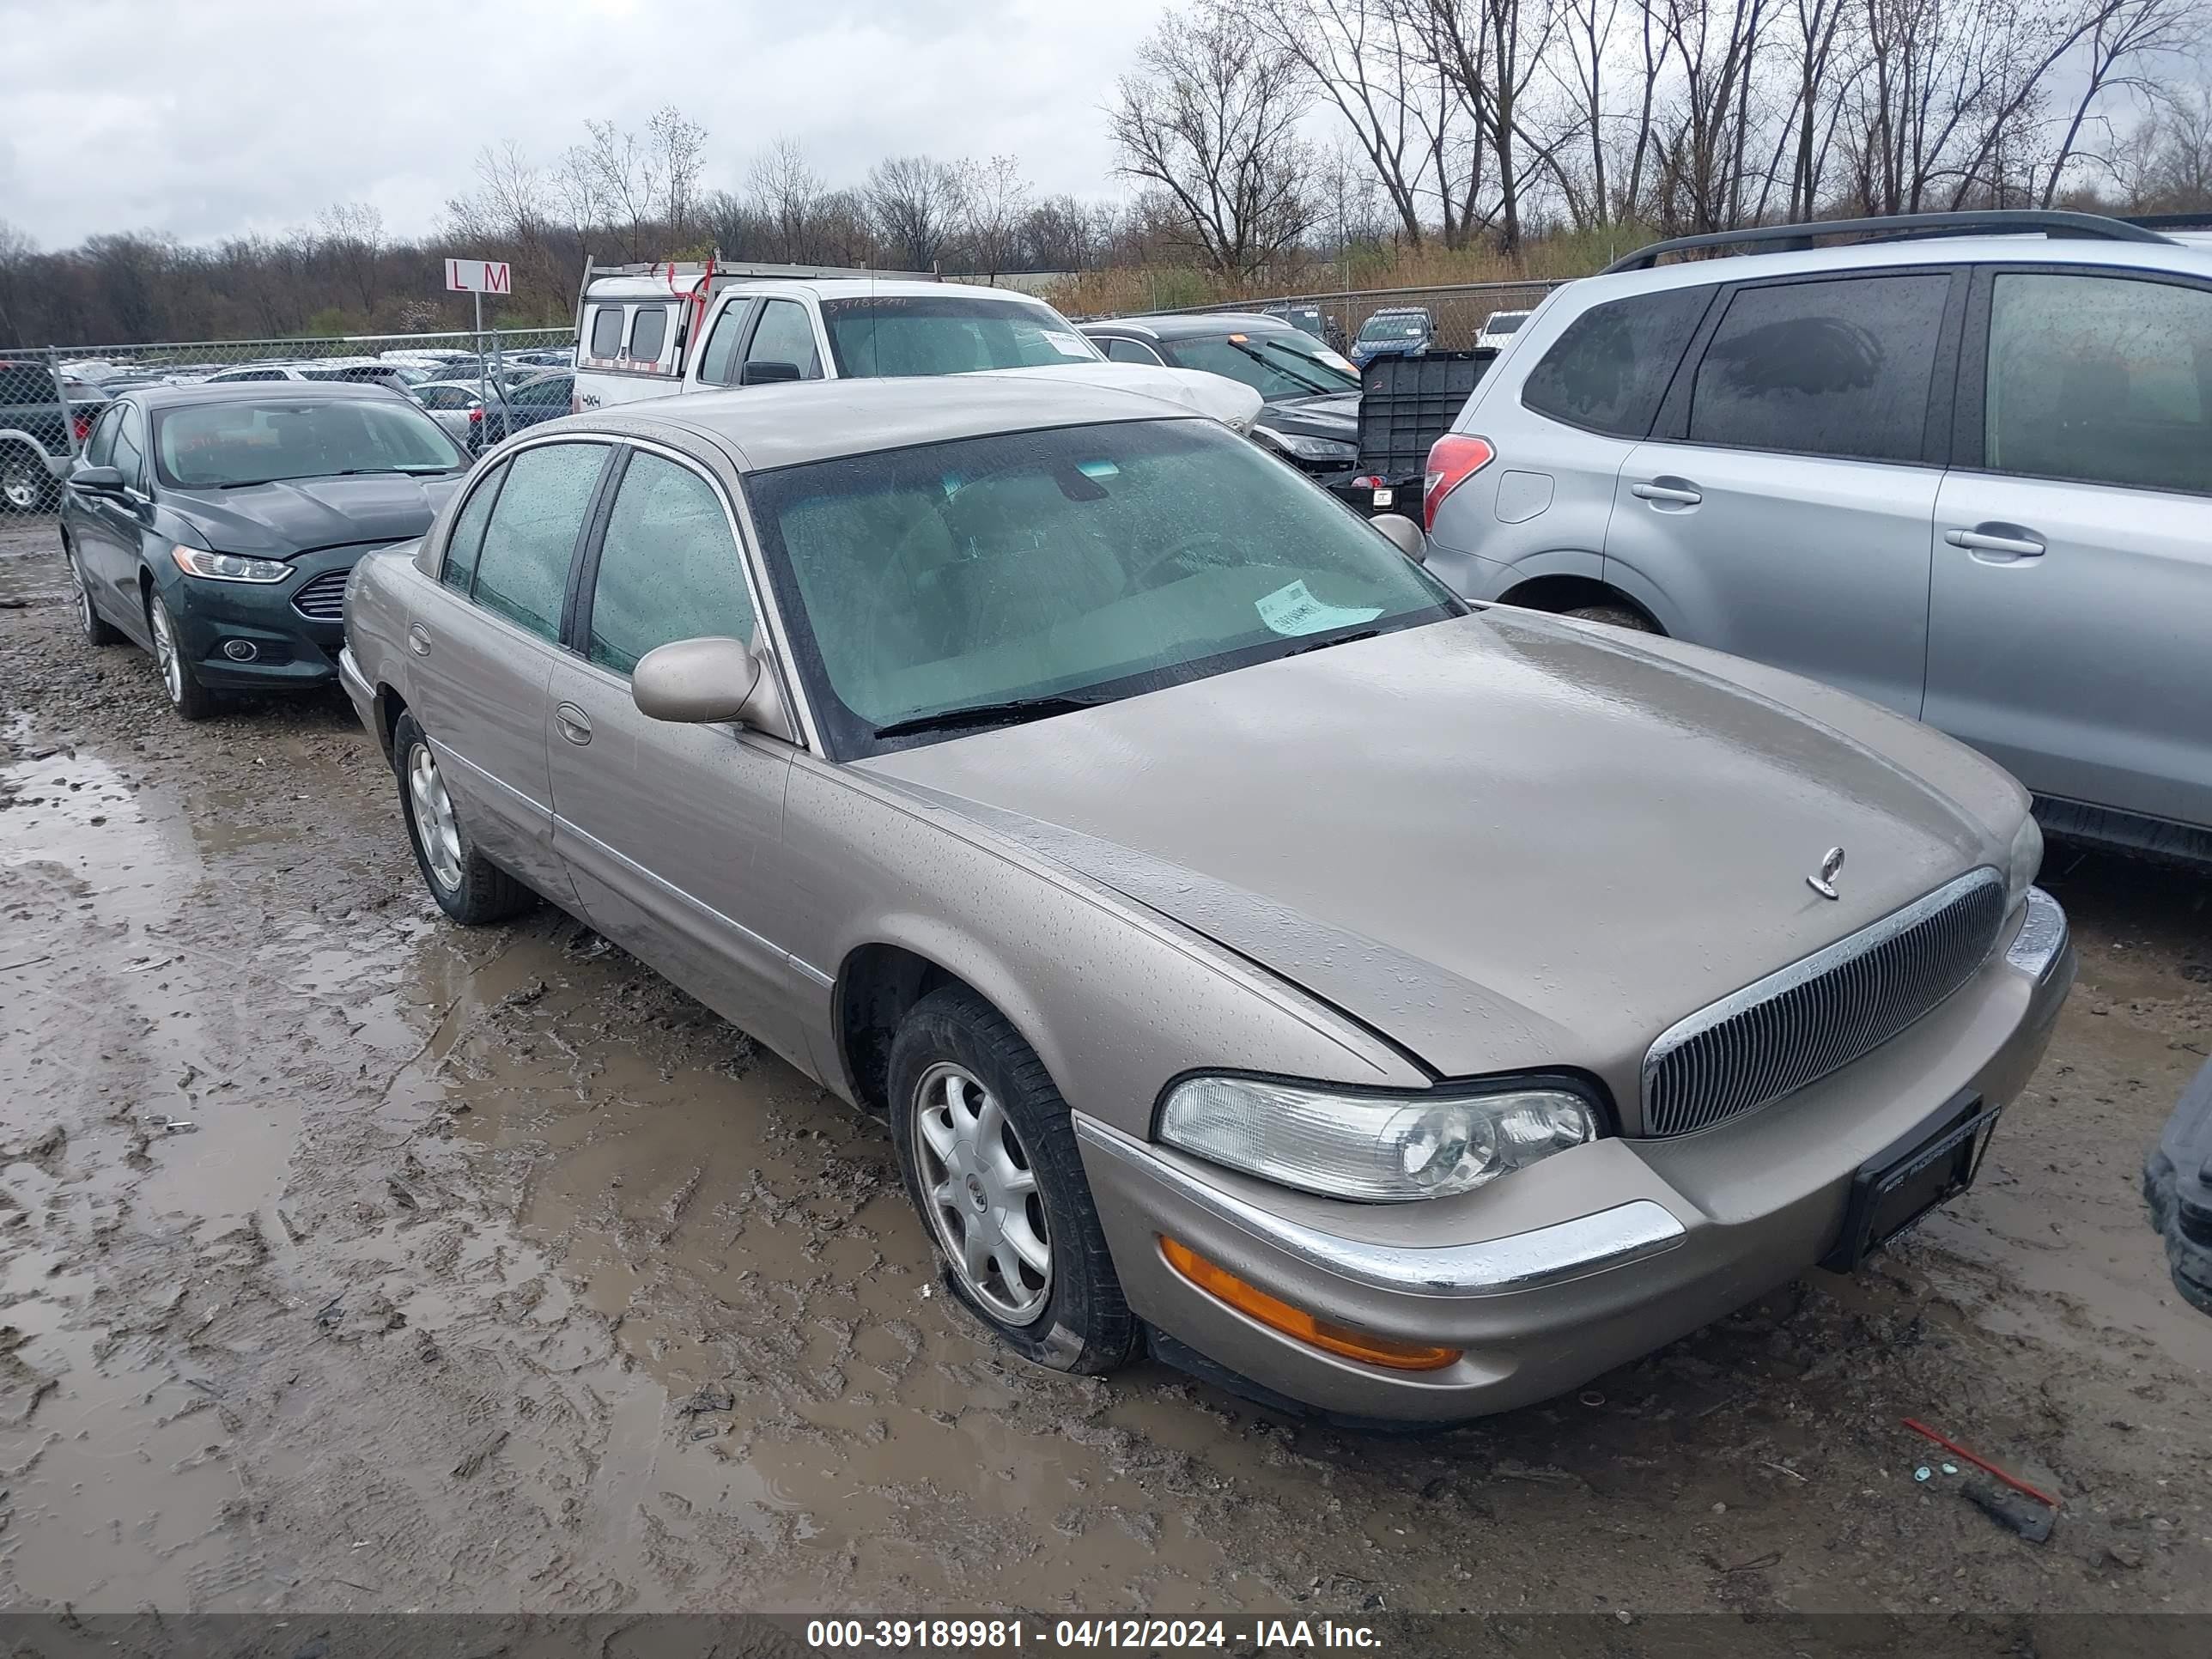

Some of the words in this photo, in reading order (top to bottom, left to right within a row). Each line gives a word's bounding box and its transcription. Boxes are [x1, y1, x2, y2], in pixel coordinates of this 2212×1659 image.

[453, 260, 468, 289] L
[485, 263, 508, 291] M
[1805, 908, 1929, 975] BUICK
